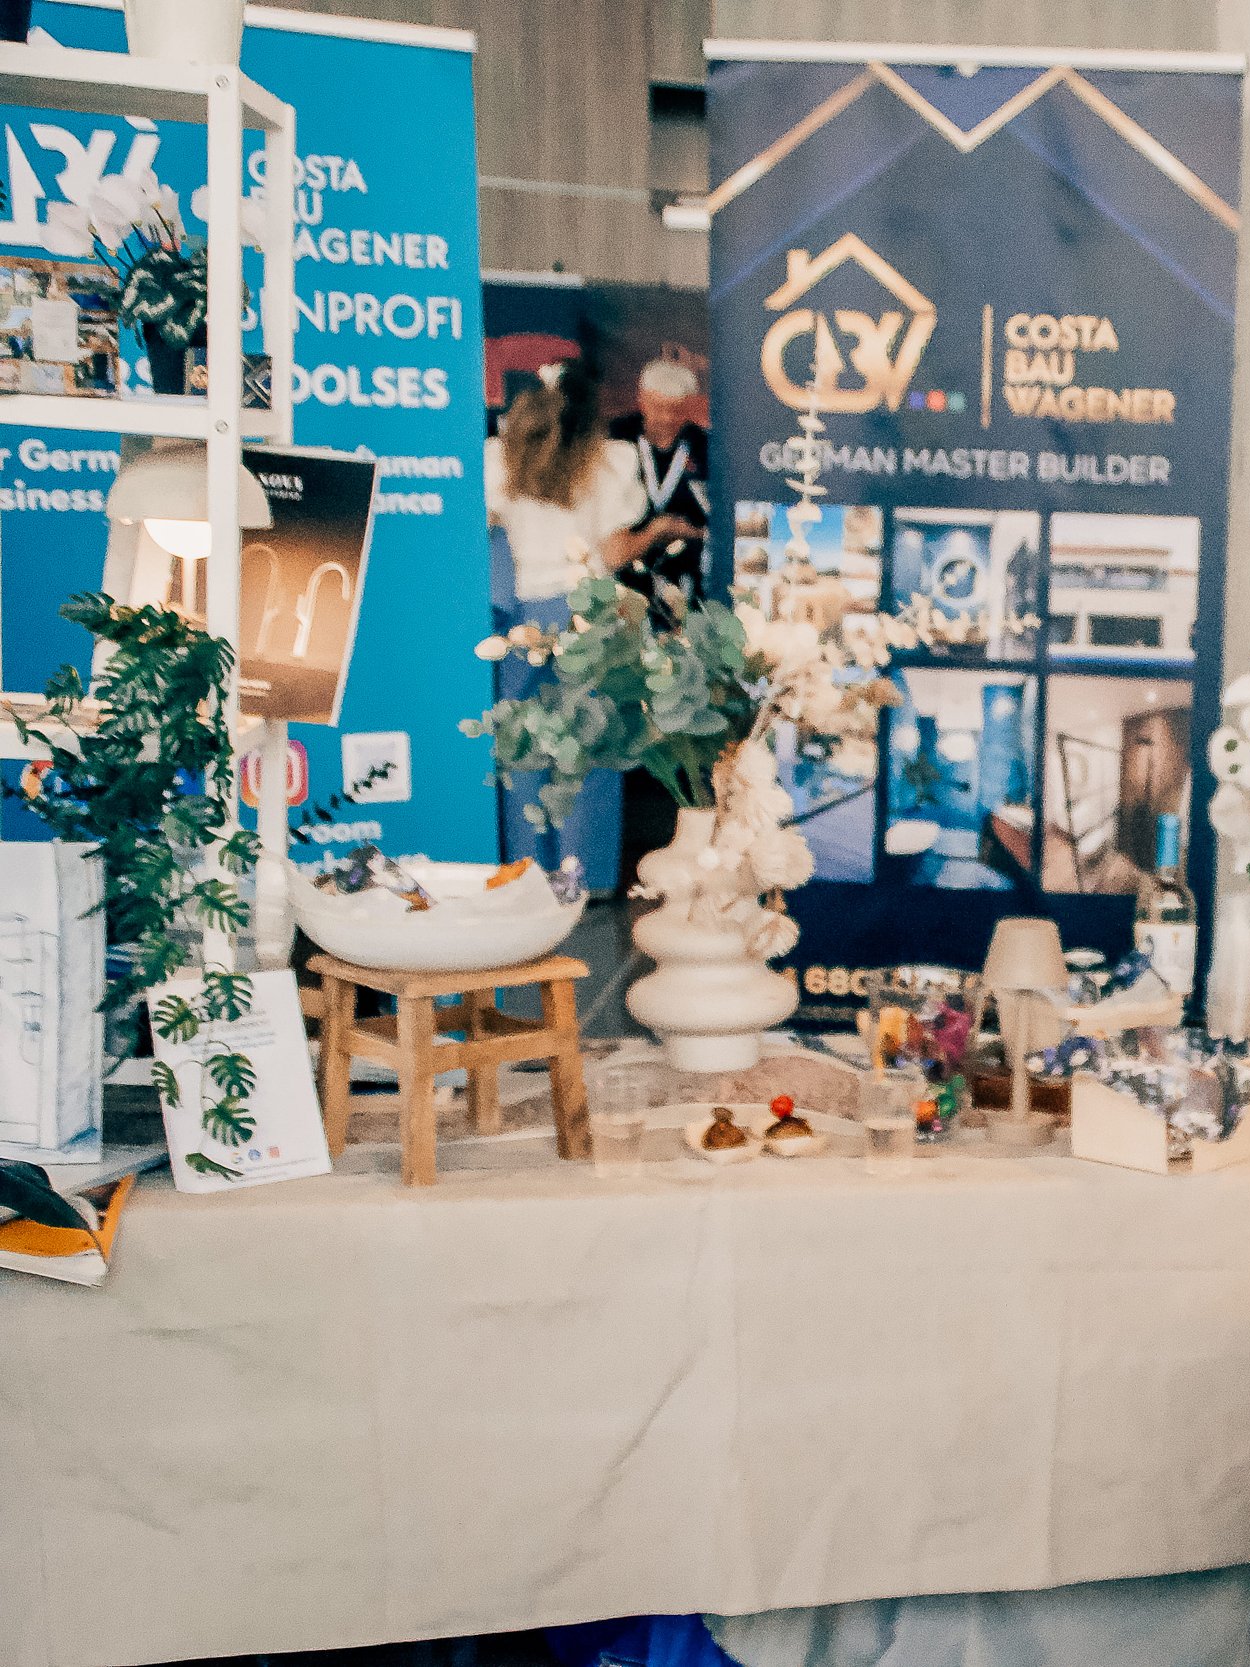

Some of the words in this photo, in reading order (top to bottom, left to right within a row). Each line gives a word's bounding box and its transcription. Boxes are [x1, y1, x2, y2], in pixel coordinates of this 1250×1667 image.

[294, 226, 449, 270] AGENER
[1004, 312, 1120, 352] COSTA
[1003, 350, 1076, 387] BAU
[1002, 385, 1177, 424] WAGENER
[902, 446, 1030, 480] MASTER
[1038, 450, 1172, 487] BUILDER
